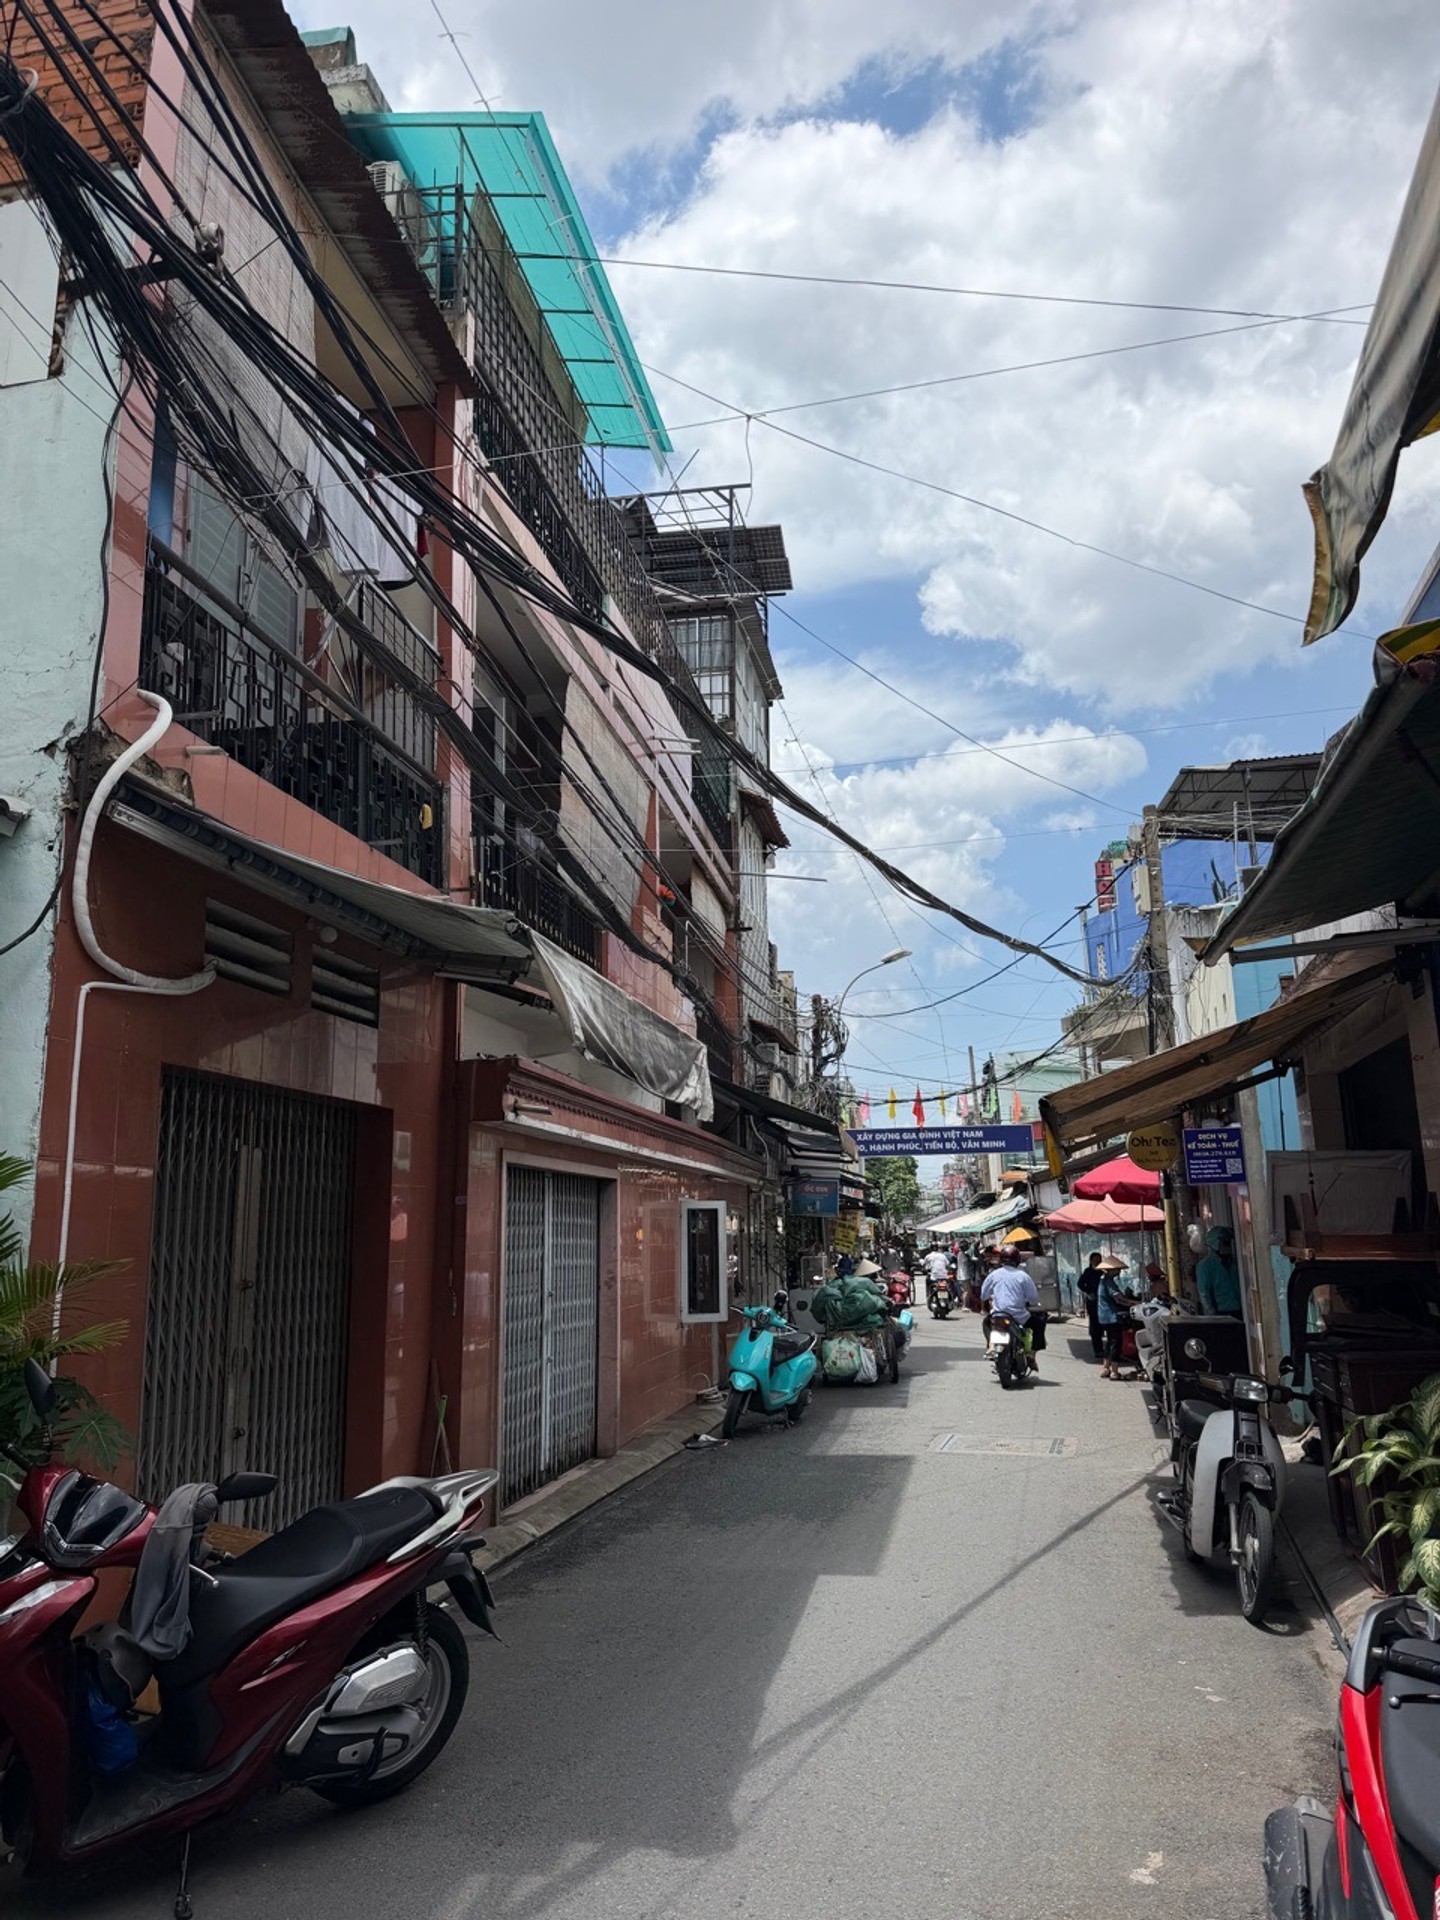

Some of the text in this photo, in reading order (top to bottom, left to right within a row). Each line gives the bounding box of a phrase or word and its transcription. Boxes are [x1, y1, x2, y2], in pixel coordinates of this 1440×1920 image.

[856, 1129, 984, 1142] XÂY DỰNG GIA ĐÌNH VIỆT NAM
[1131, 1136, 1152, 1147] Oh!
[869, 1143, 895, 1152] HẠNH
[897, 1141, 922, 1151] PHÚC,
[924, 1139, 944, 1150] TIẾN
[946, 1140, 960, 1150] BỘ,
[961, 1139, 980, 1149] VĂN
[981, 1140, 1006, 1148] MINH
